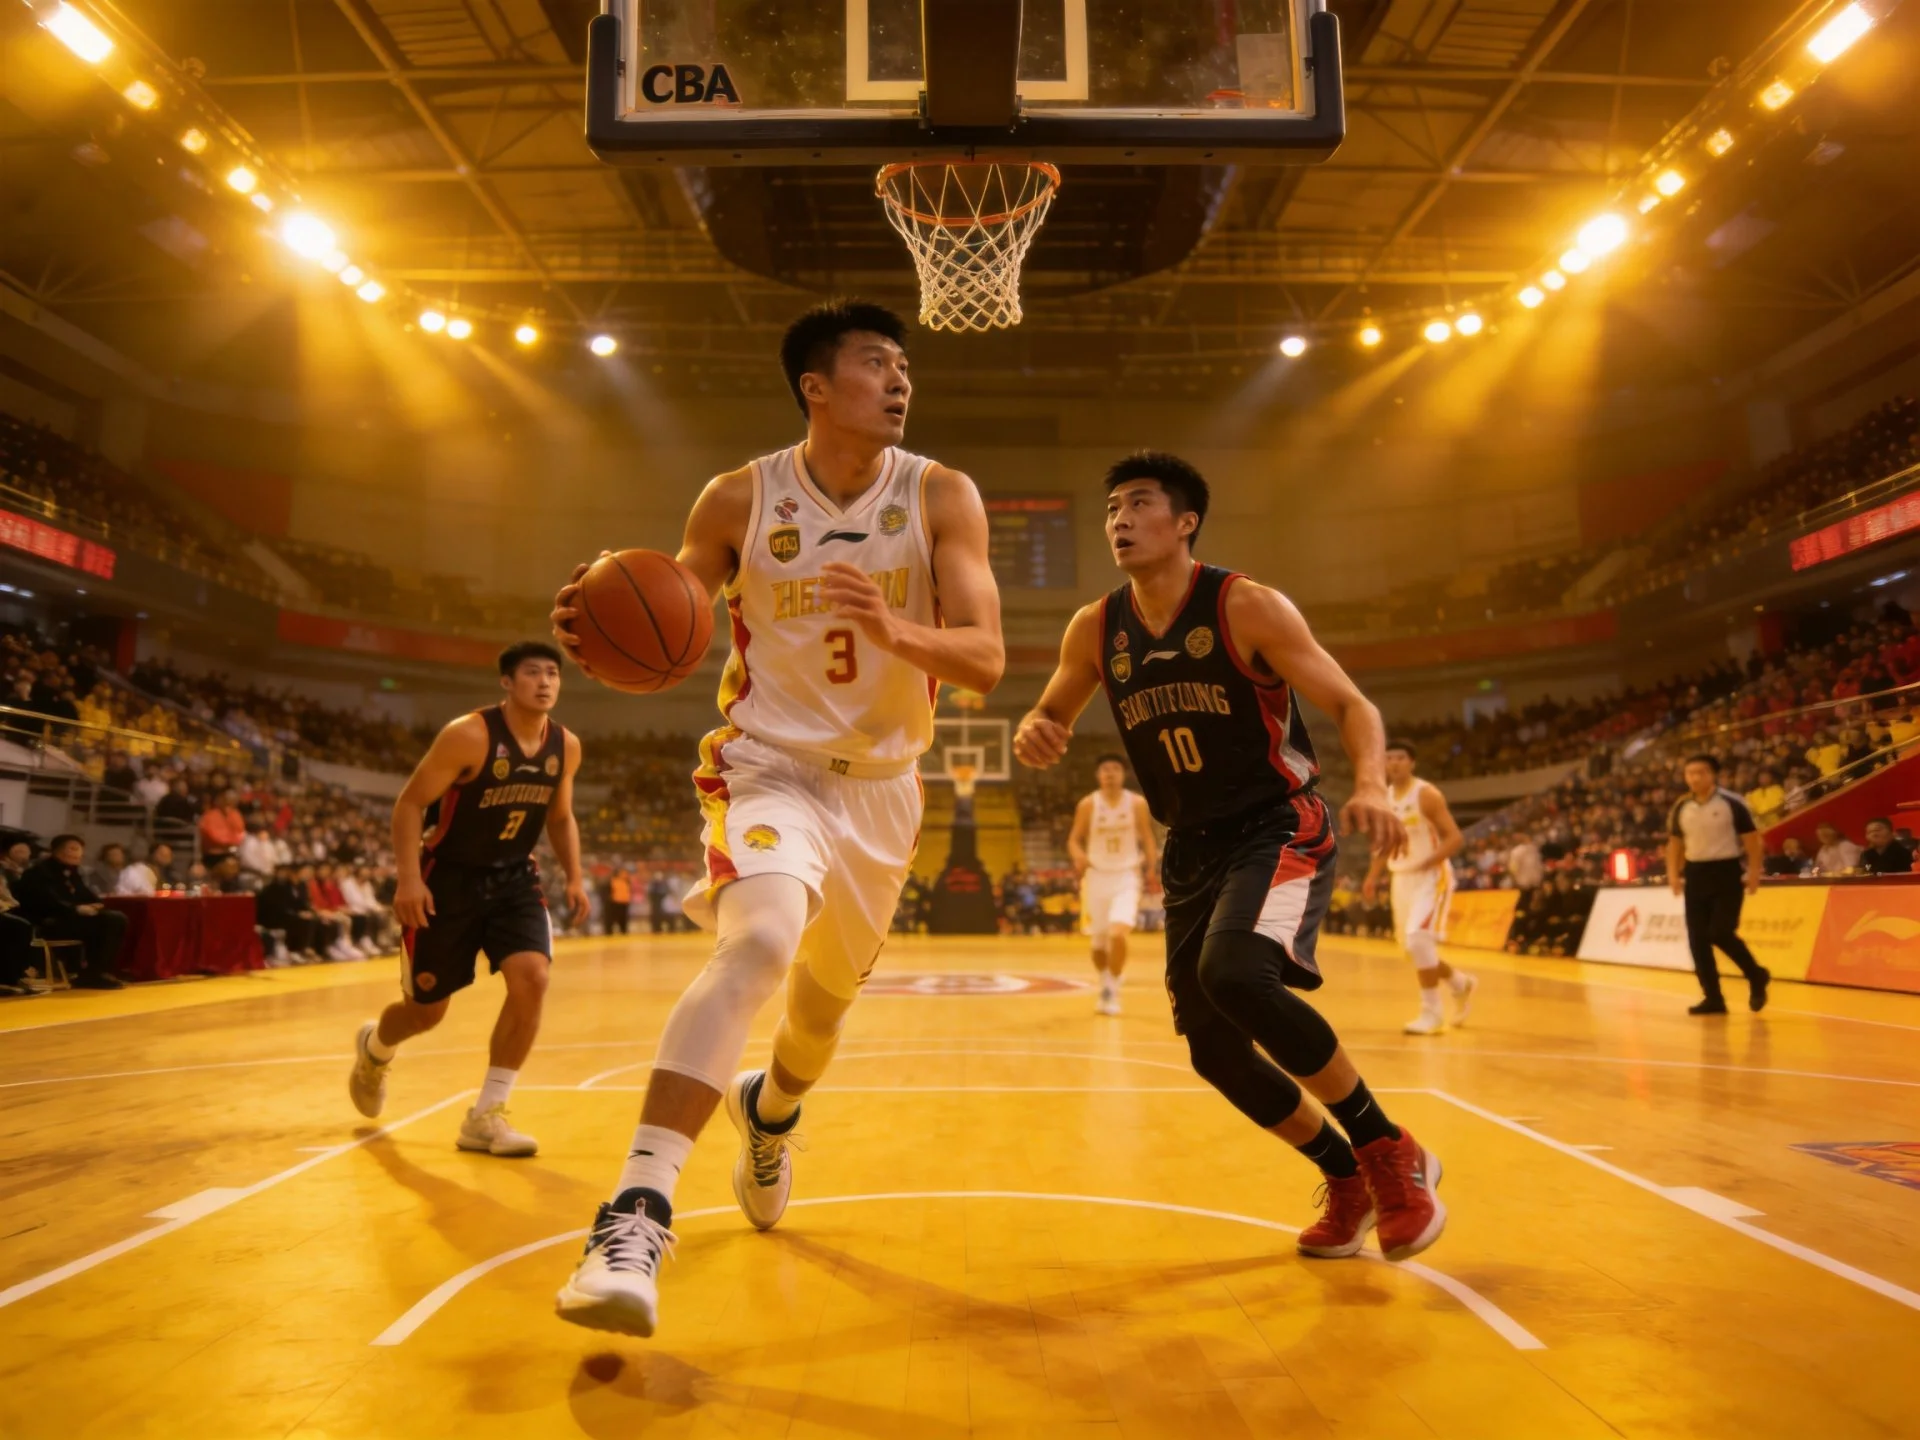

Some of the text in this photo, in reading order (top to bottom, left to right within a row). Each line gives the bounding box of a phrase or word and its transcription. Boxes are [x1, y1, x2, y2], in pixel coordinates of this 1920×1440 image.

[642, 64, 742, 103] CBA
[824, 629, 857, 684] 3
[1158, 727, 1203, 774] 10
